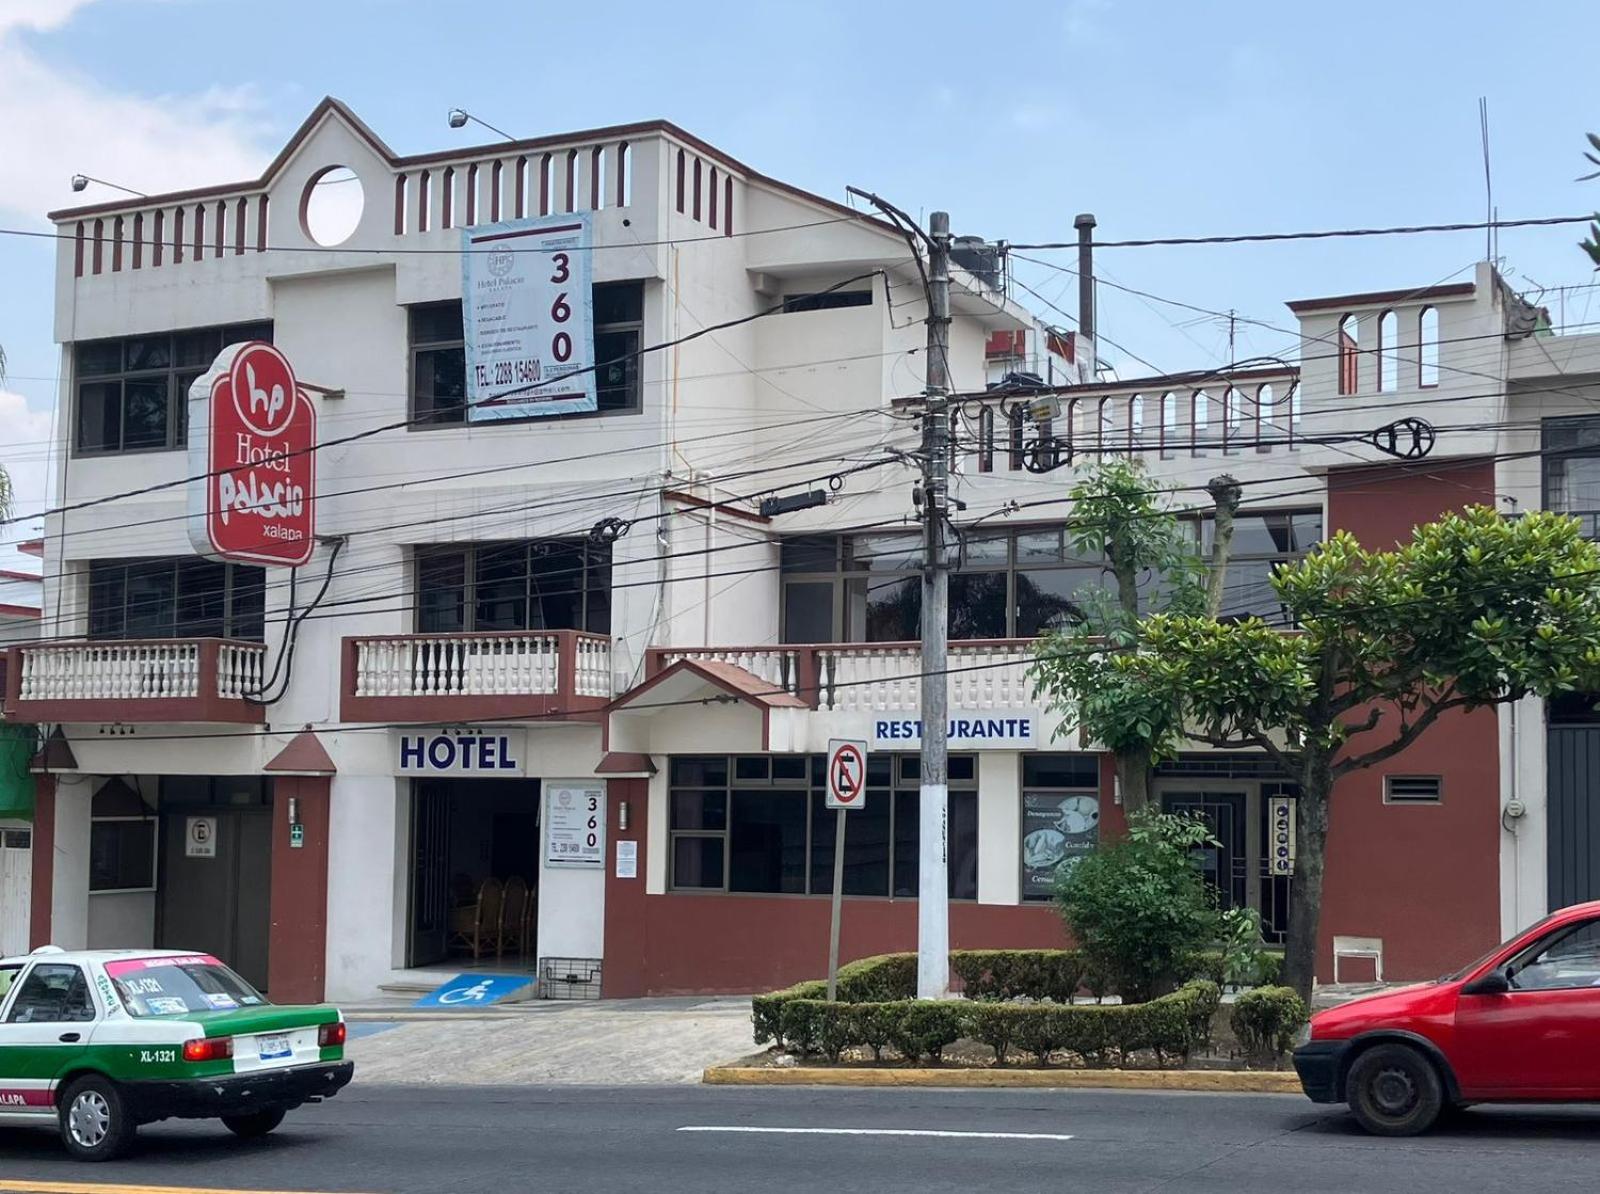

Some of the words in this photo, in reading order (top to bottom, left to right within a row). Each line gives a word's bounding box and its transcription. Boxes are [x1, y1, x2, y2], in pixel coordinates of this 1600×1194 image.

[236, 432, 291, 472] Hotel
[219, 471, 303, 526] Palacio
[876, 719, 1030, 739] RESTURANTE
[400, 736, 516, 769] HOTEL
[141, 1050, 175, 1062] XL-1321
